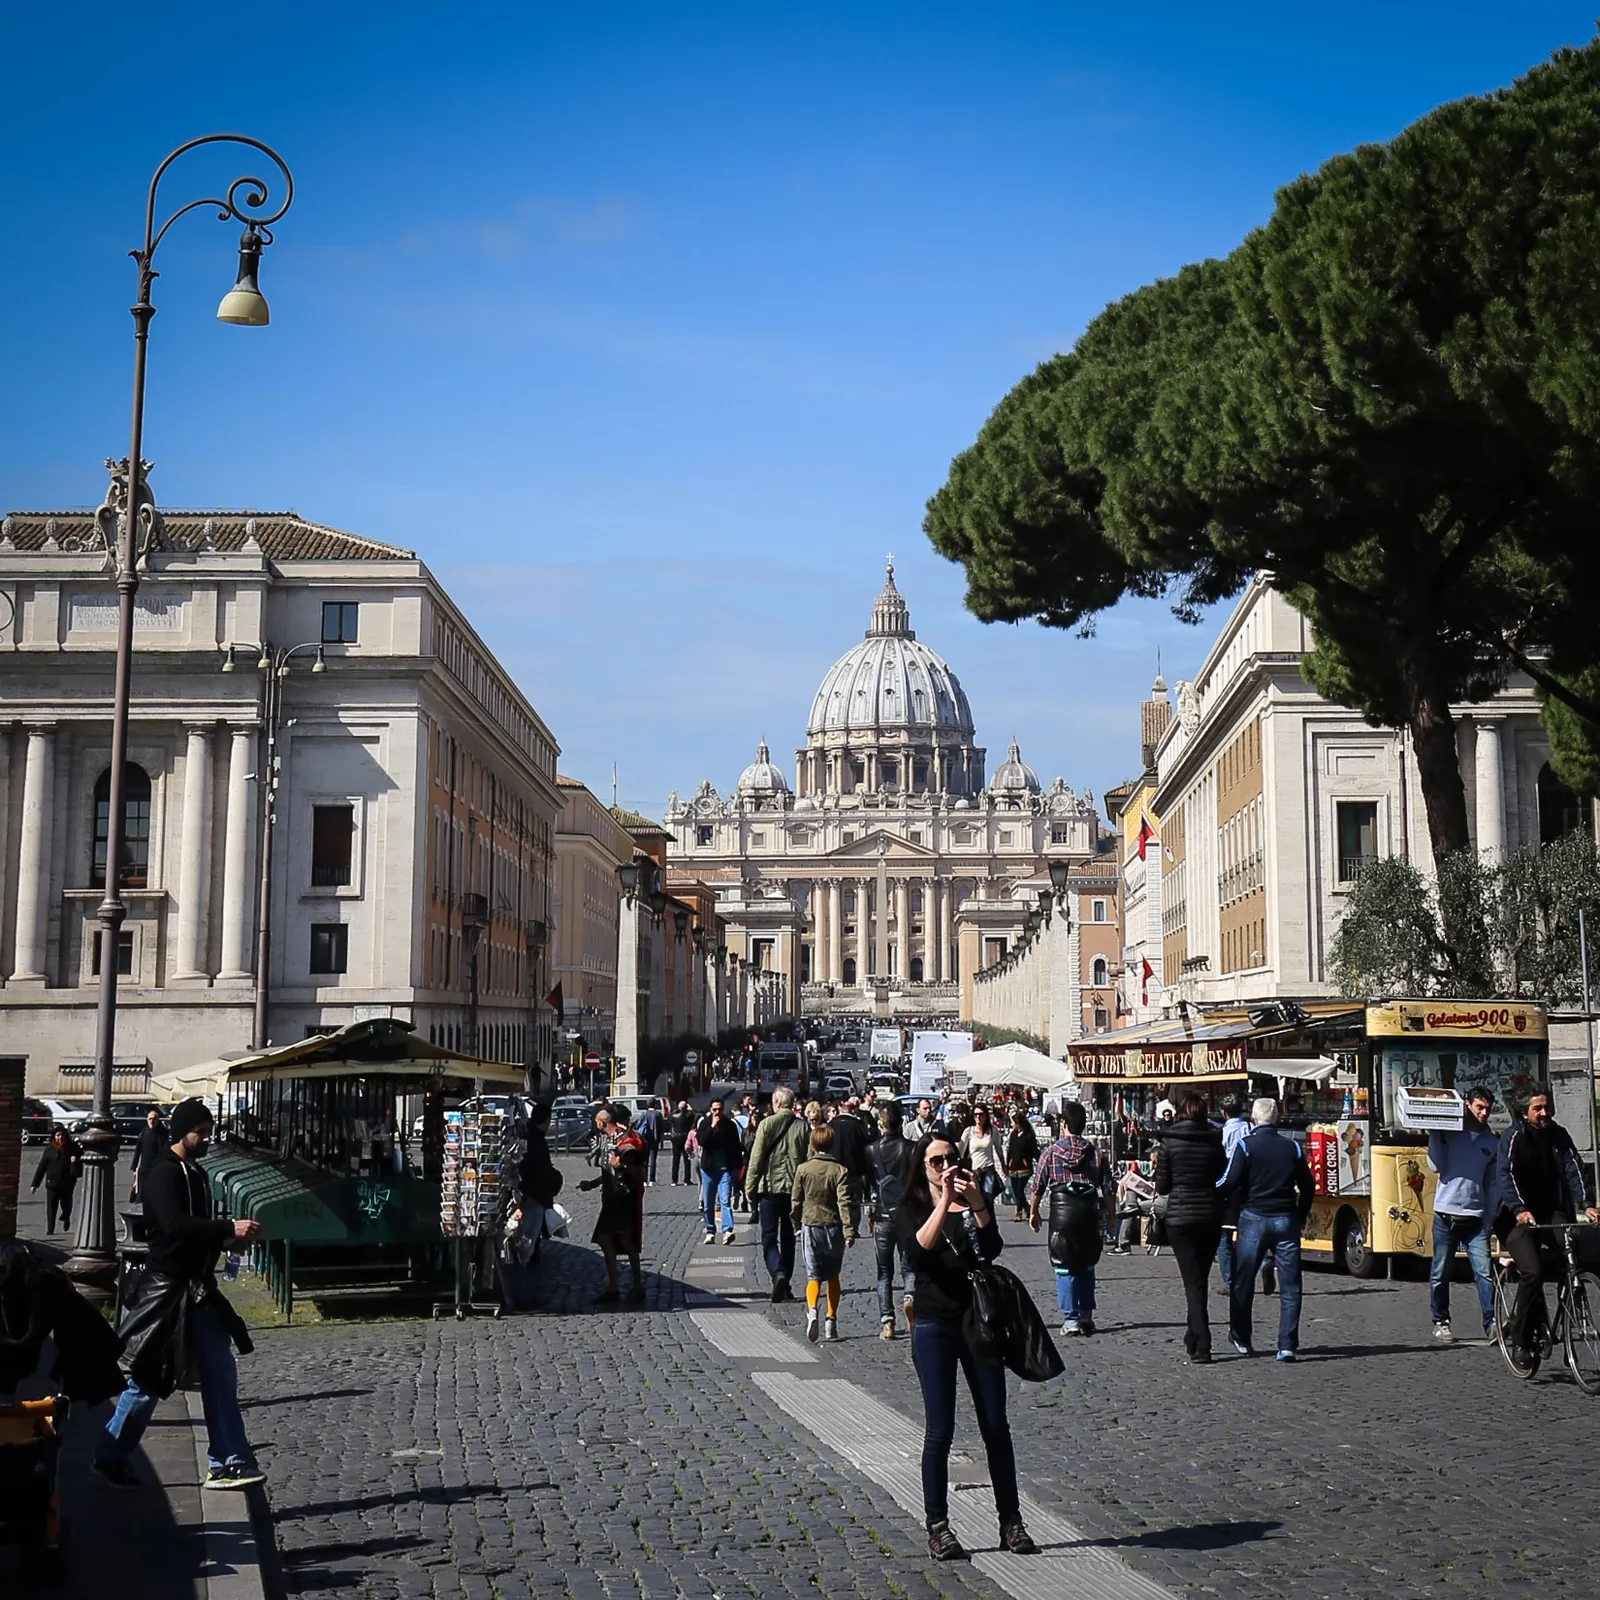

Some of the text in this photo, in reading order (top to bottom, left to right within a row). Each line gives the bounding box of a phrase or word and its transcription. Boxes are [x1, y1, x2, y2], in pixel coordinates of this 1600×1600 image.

[1136, 1053, 1175, 1074] GELATI
[1200, 1048, 1242, 1072] CREAM
[1326, 1141, 1337, 1193] CRIK CROK
